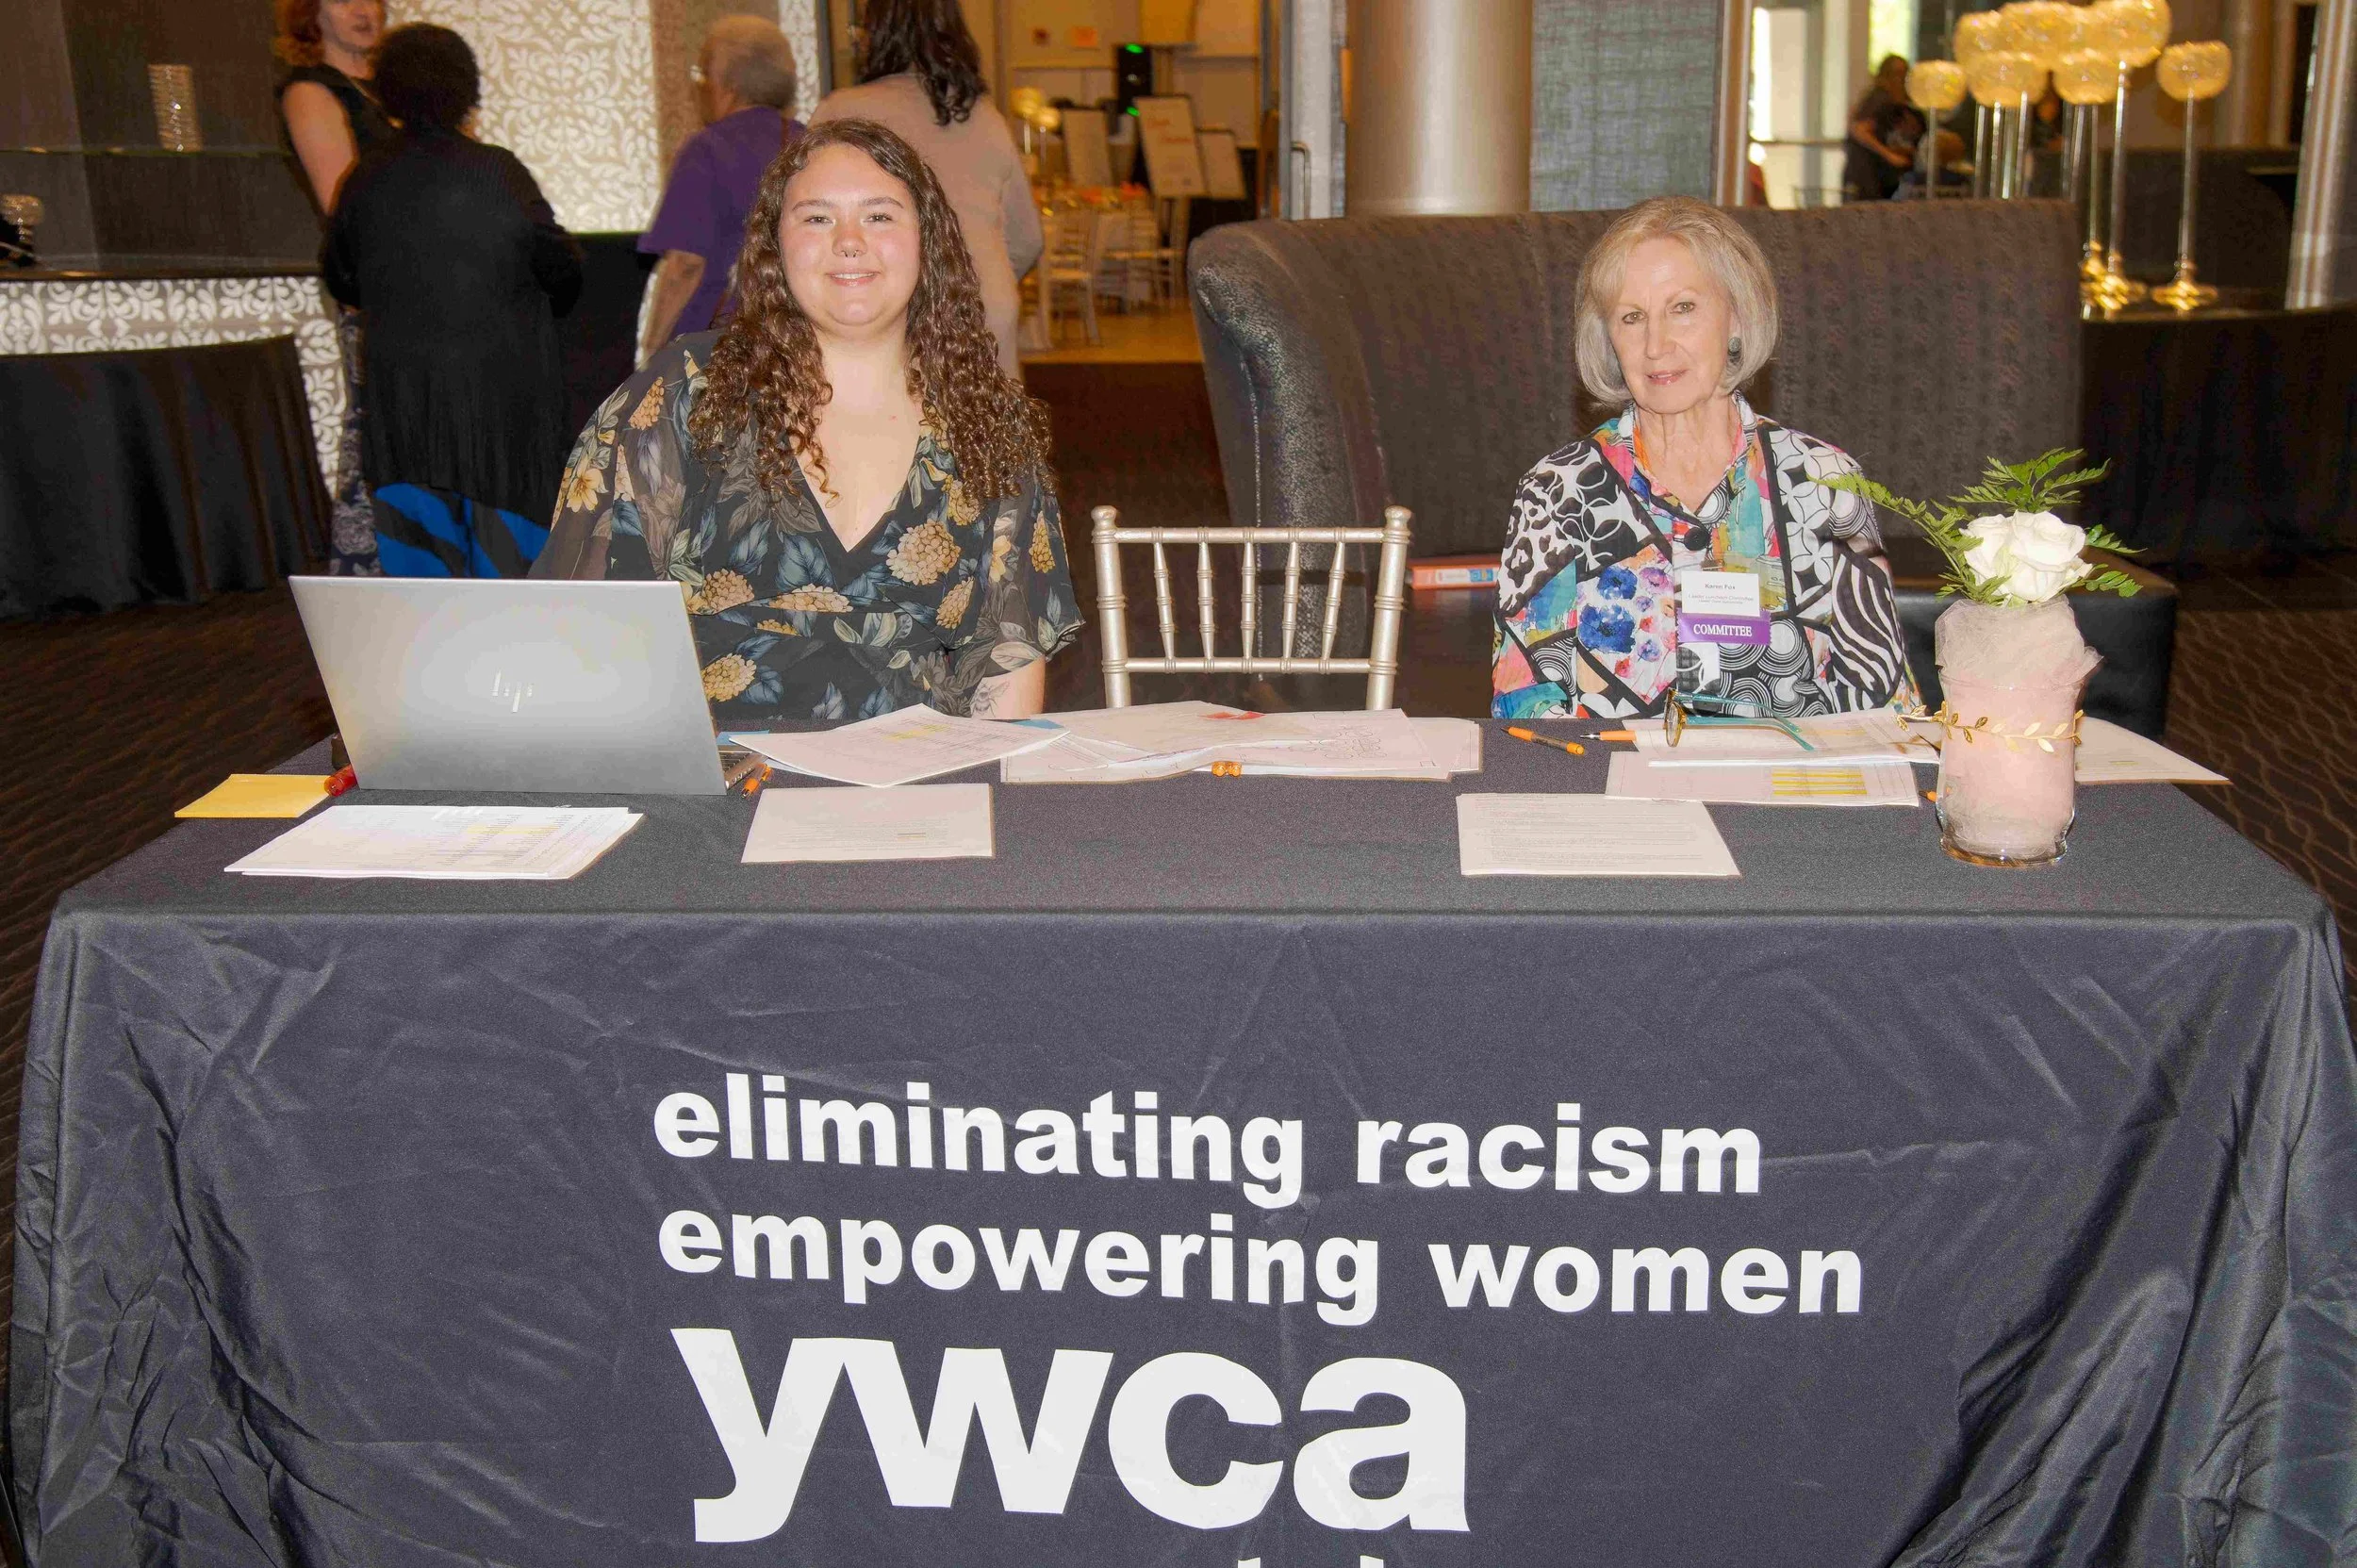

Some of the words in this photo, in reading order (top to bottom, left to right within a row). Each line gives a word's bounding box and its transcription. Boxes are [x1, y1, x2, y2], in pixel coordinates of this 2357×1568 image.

[1693, 623, 1752, 637] COMMITTEE
[653, 1072, 1303, 1210] eliminating
[1357, 1102, 1760, 1194] racism
[658, 1210, 1378, 1327] empowering
[1427, 1244, 1861, 1314] women
[670, 1328, 1471, 1543] ywca
